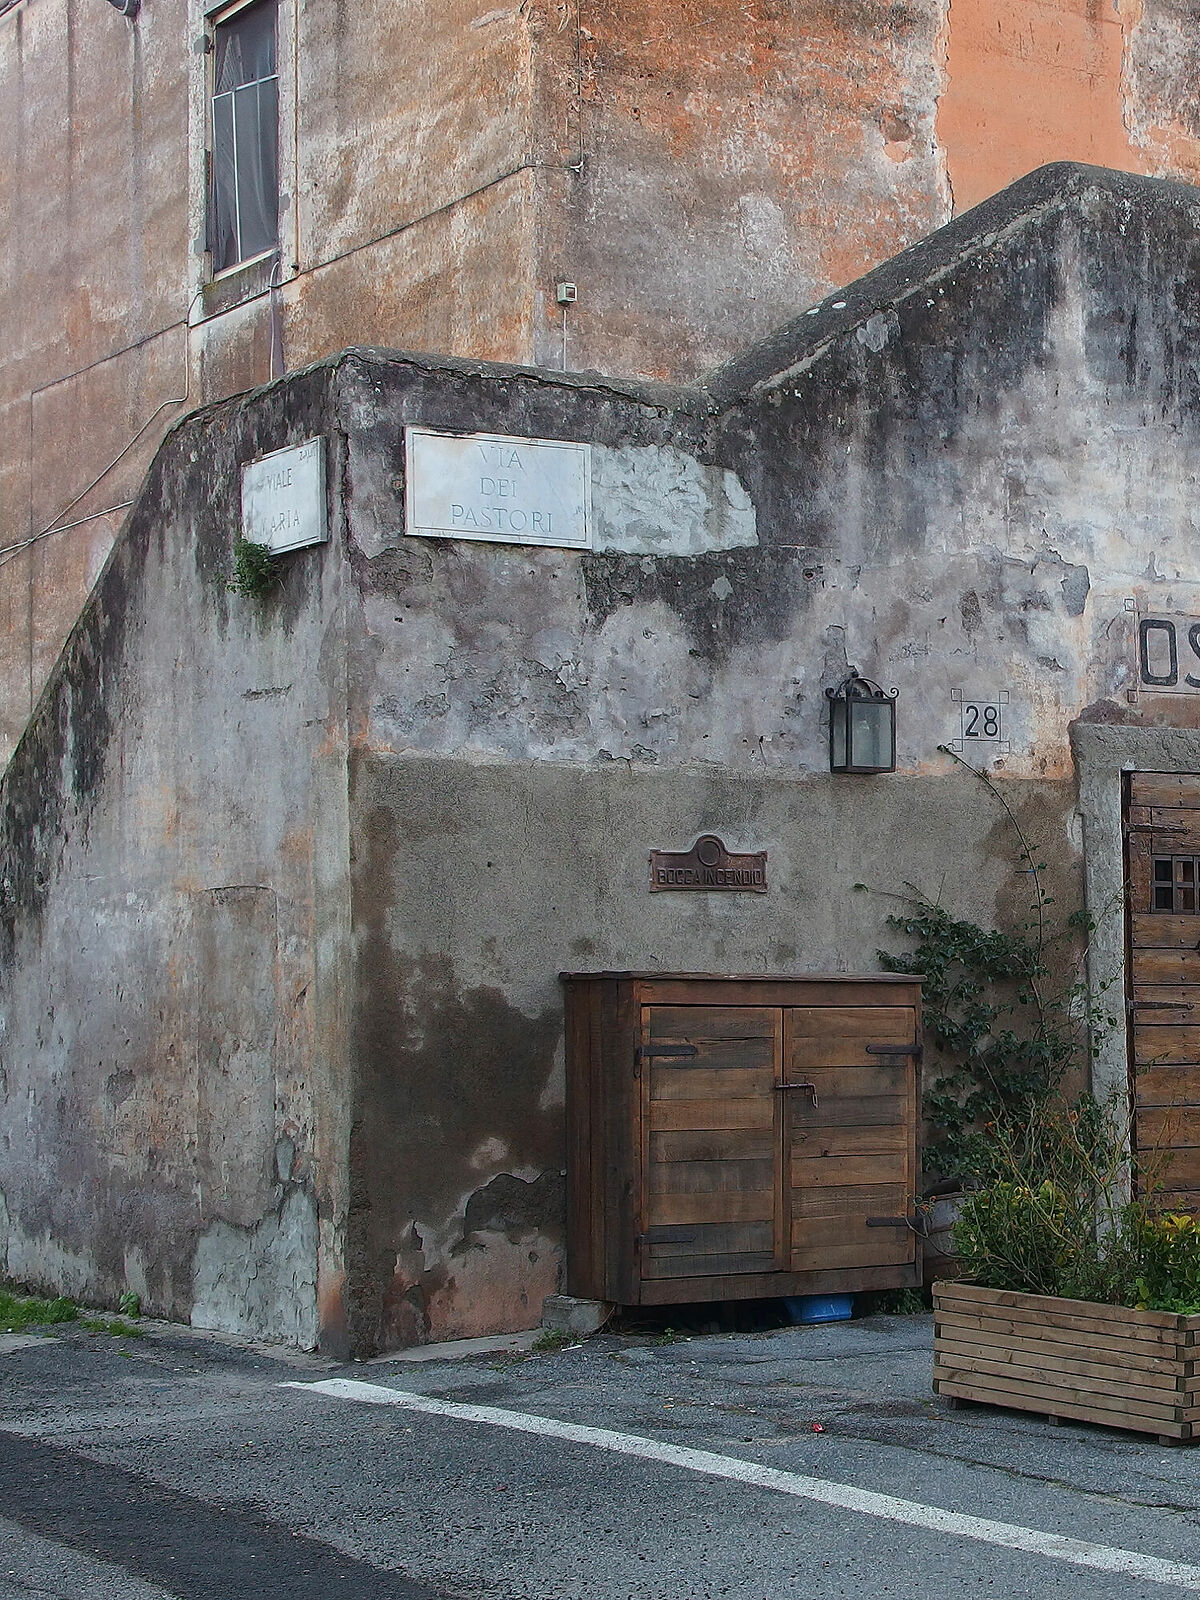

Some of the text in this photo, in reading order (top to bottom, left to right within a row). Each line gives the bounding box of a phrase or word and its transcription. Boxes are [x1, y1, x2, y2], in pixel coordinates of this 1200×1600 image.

[477, 445, 525, 470] VIA
[266, 468, 292, 492] VIALE
[479, 477, 517, 498] DEI
[451, 504, 553, 533] PASTORI
[965, 705, 998, 737] 28
[657, 868, 762, 885] BOCCA INCENDIO
